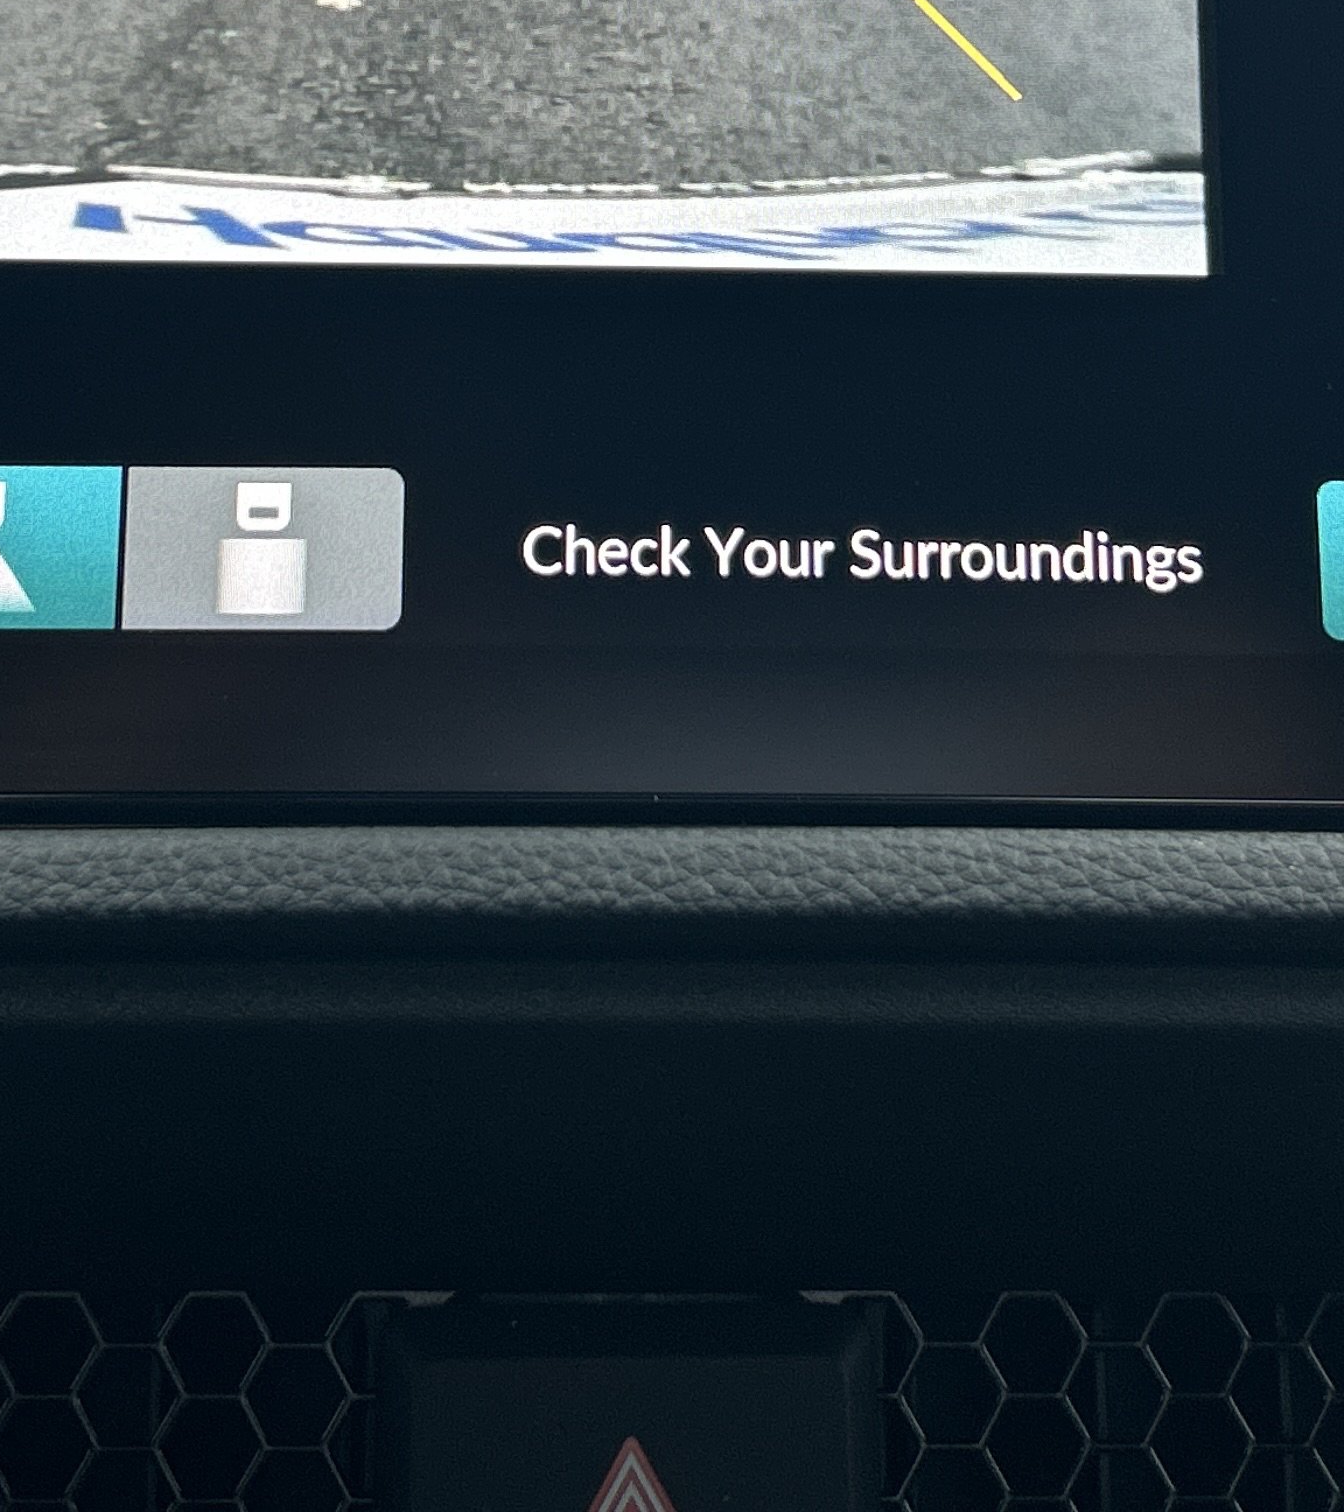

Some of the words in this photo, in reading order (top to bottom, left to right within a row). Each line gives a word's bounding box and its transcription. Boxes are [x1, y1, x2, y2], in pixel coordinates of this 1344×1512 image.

[522, 523, 692, 577] Check
[703, 526, 836, 579] Your
[849, 528, 1204, 594] Surroundings
